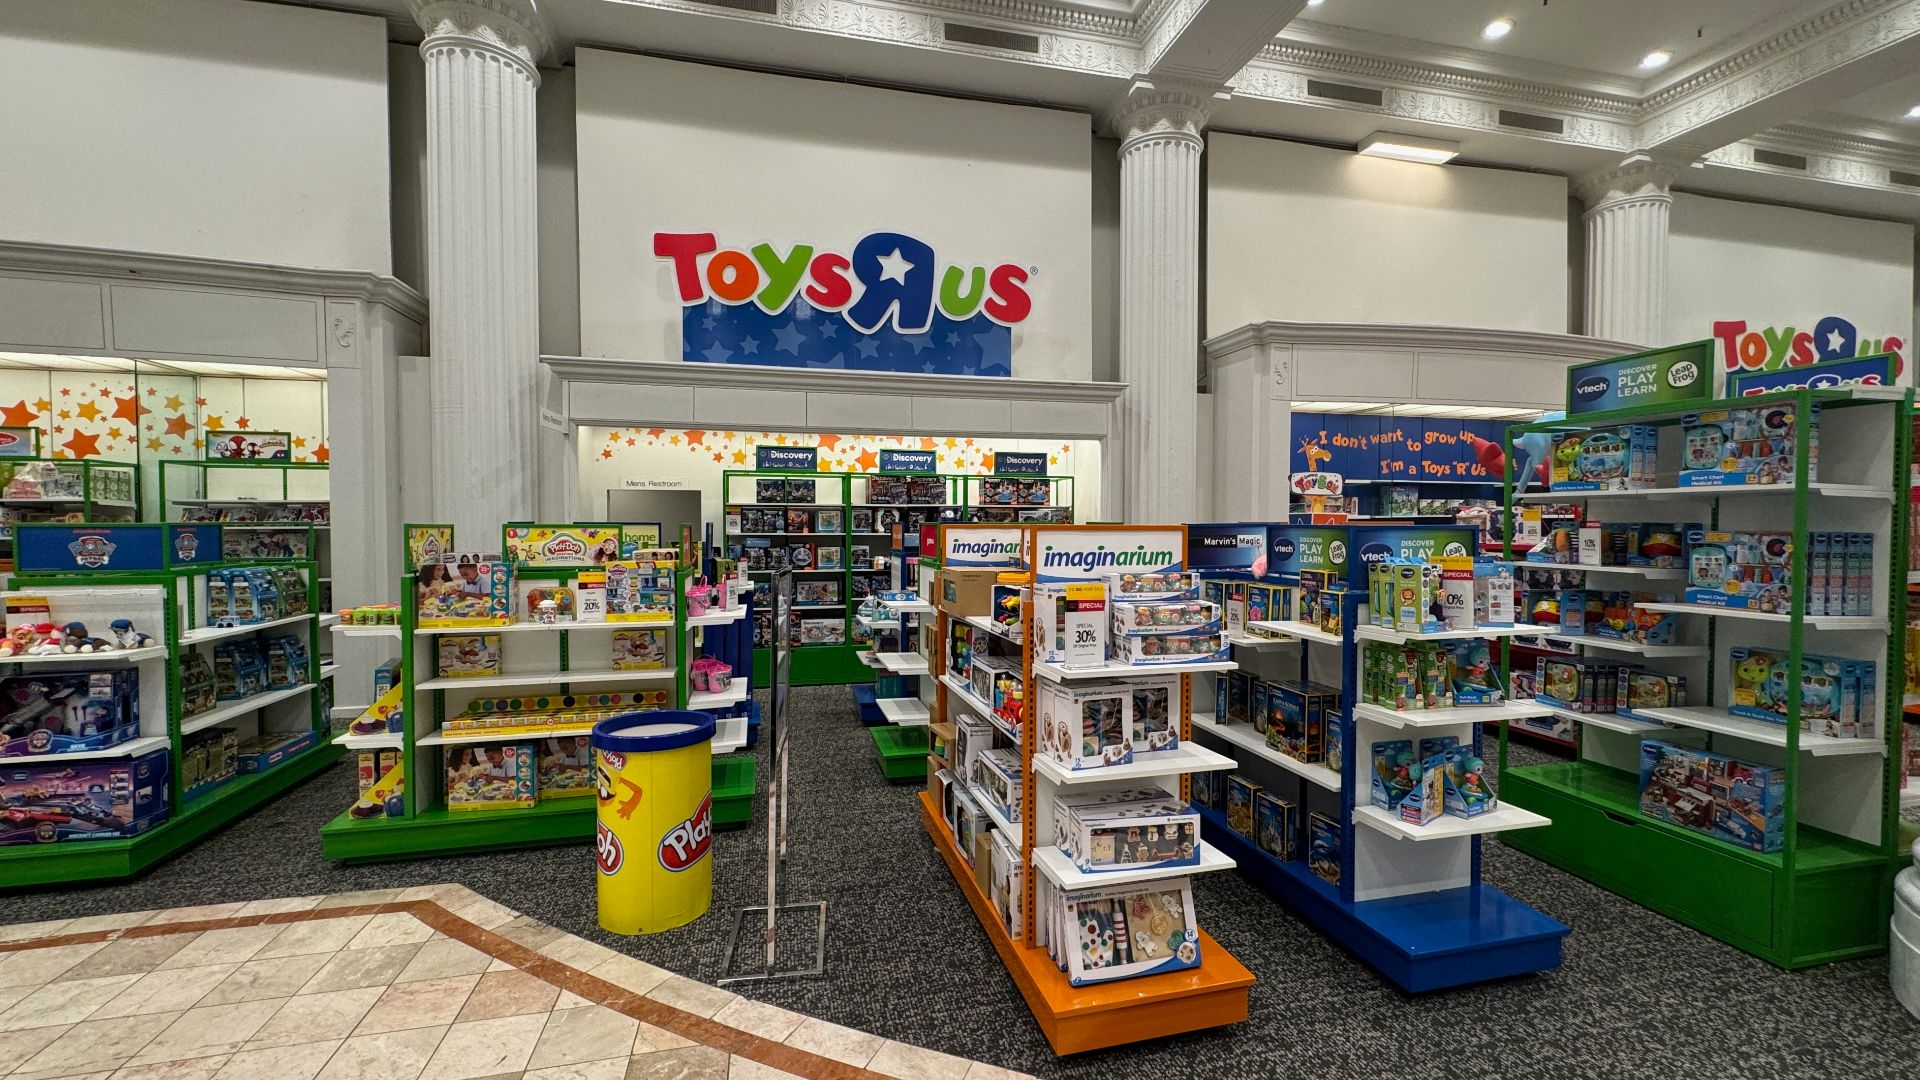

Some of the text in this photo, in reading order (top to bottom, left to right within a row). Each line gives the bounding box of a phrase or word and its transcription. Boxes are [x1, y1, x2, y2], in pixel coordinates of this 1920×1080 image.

[1618, 364, 1657, 376] DISCOVER
[1671, 362, 1693, 377] Leap
[1618, 372, 1656, 387] PLAY
[1673, 370, 1695, 384] Frog
[1577, 382, 1607, 394] vtech
[1617, 384, 1657, 397] LEARN
[1319, 429, 1475, 452] I don't want to grow up
[771, 451, 812, 460] Discovery
[893, 453, 932, 463] Discovery
[1007, 456, 1043, 466] Discovery
[1380, 459, 1403, 474] I'm
[1409, 465, 1416, 475] a
[1422, 460, 1450, 477] Toys
[1471, 463, 1486, 476] Us
[624, 533, 656, 542] home
[1204, 537, 1261, 546] Marvin's Magic
[952, 539, 1021, 557] imaginar
[1274, 544, 1294, 553] vtech
[1299, 544, 1323, 554] PLAY
[1445, 545, 1462, 557] Leap
[1044, 545, 1173, 572] imaginarium
[1299, 555, 1323, 564] LEARN
[1361, 551, 1391, 562] vtech
[1401, 549, 1434, 559] PLAY
[1446, 594, 1464, 605] 0%
[584, 602, 600, 611] 20%
[1075, 630, 1097, 643] 30%
[1066, 891, 1102, 902] imaginarium
[1186, 930, 1193, 938] 14
